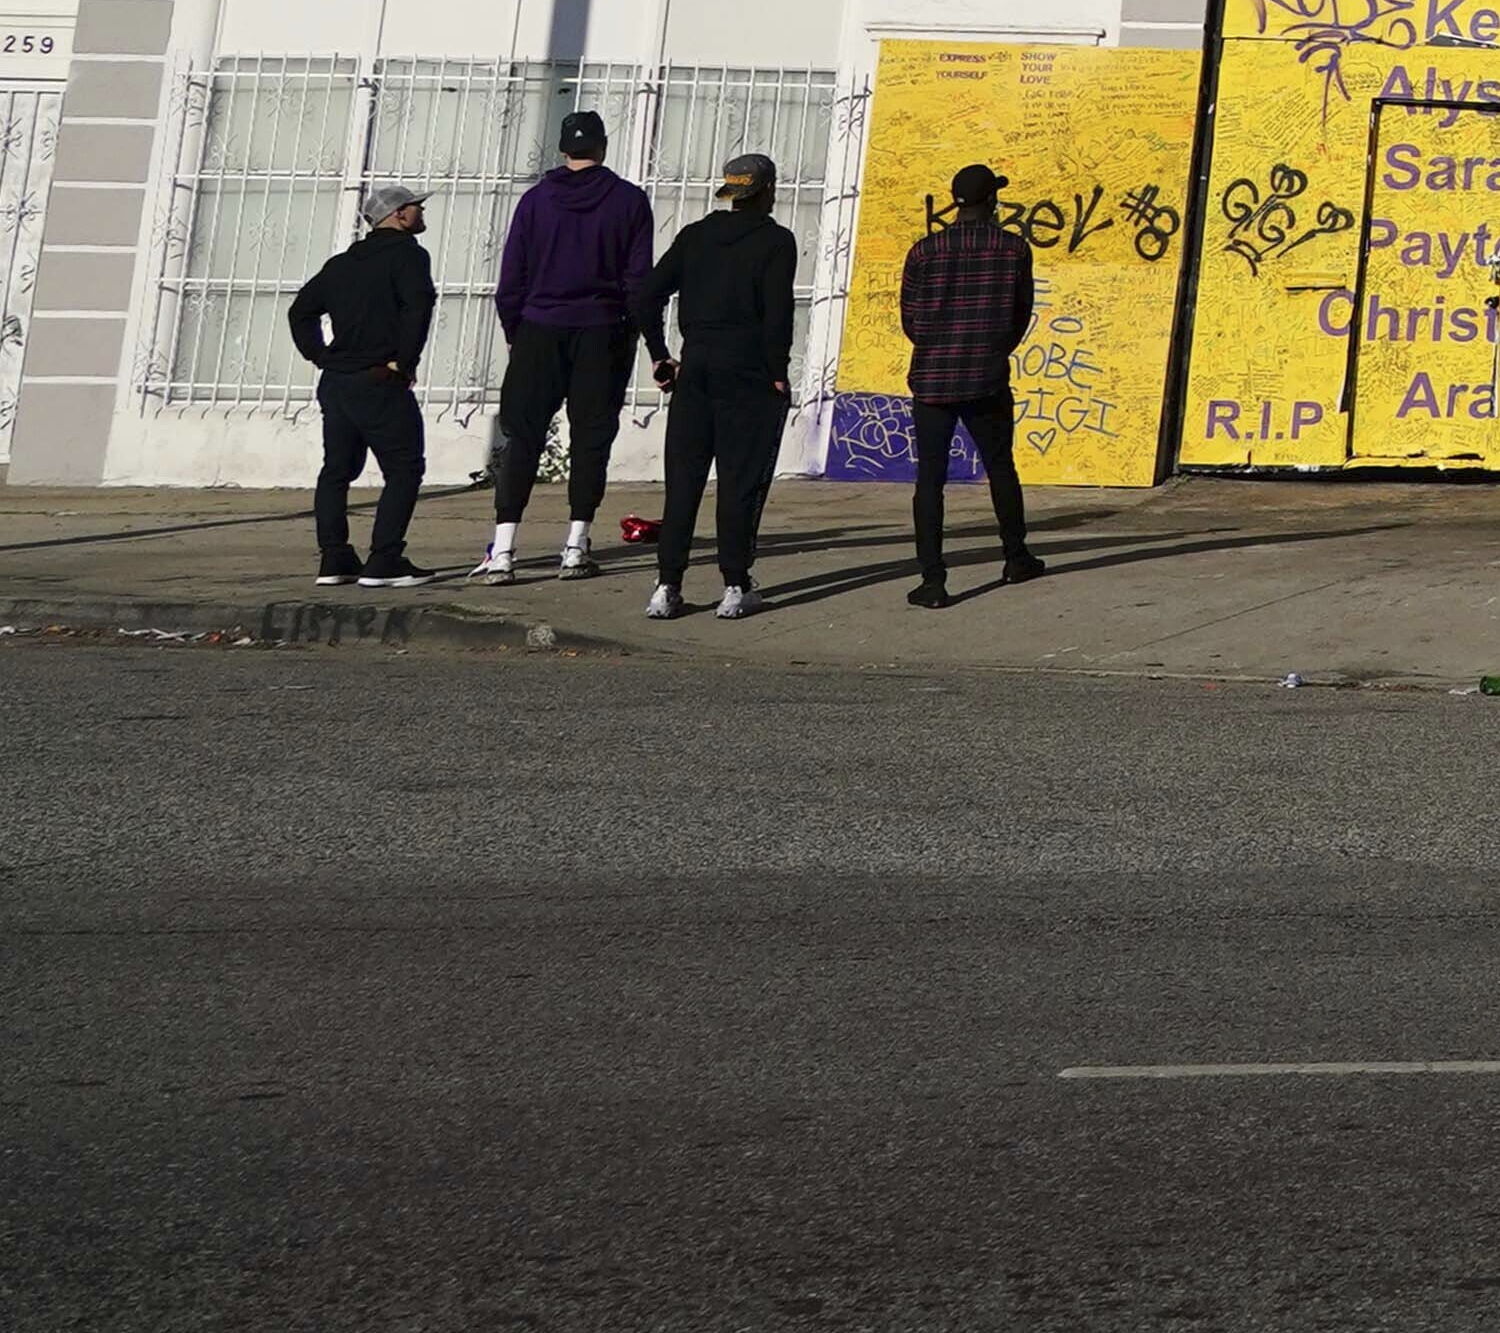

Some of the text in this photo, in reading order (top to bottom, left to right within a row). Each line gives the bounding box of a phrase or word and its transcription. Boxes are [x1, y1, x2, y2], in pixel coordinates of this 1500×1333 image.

[3, 33, 56, 55] 259
[939, 52, 1057, 64] EXPRESS SHOW
[1021, 63, 1053, 73] YOUR
[936, 70, 1051, 85] YOURSELF LOVE
[1396, 371, 1500, 420] Ara
[1206, 399, 1324, 442] R.I.P
